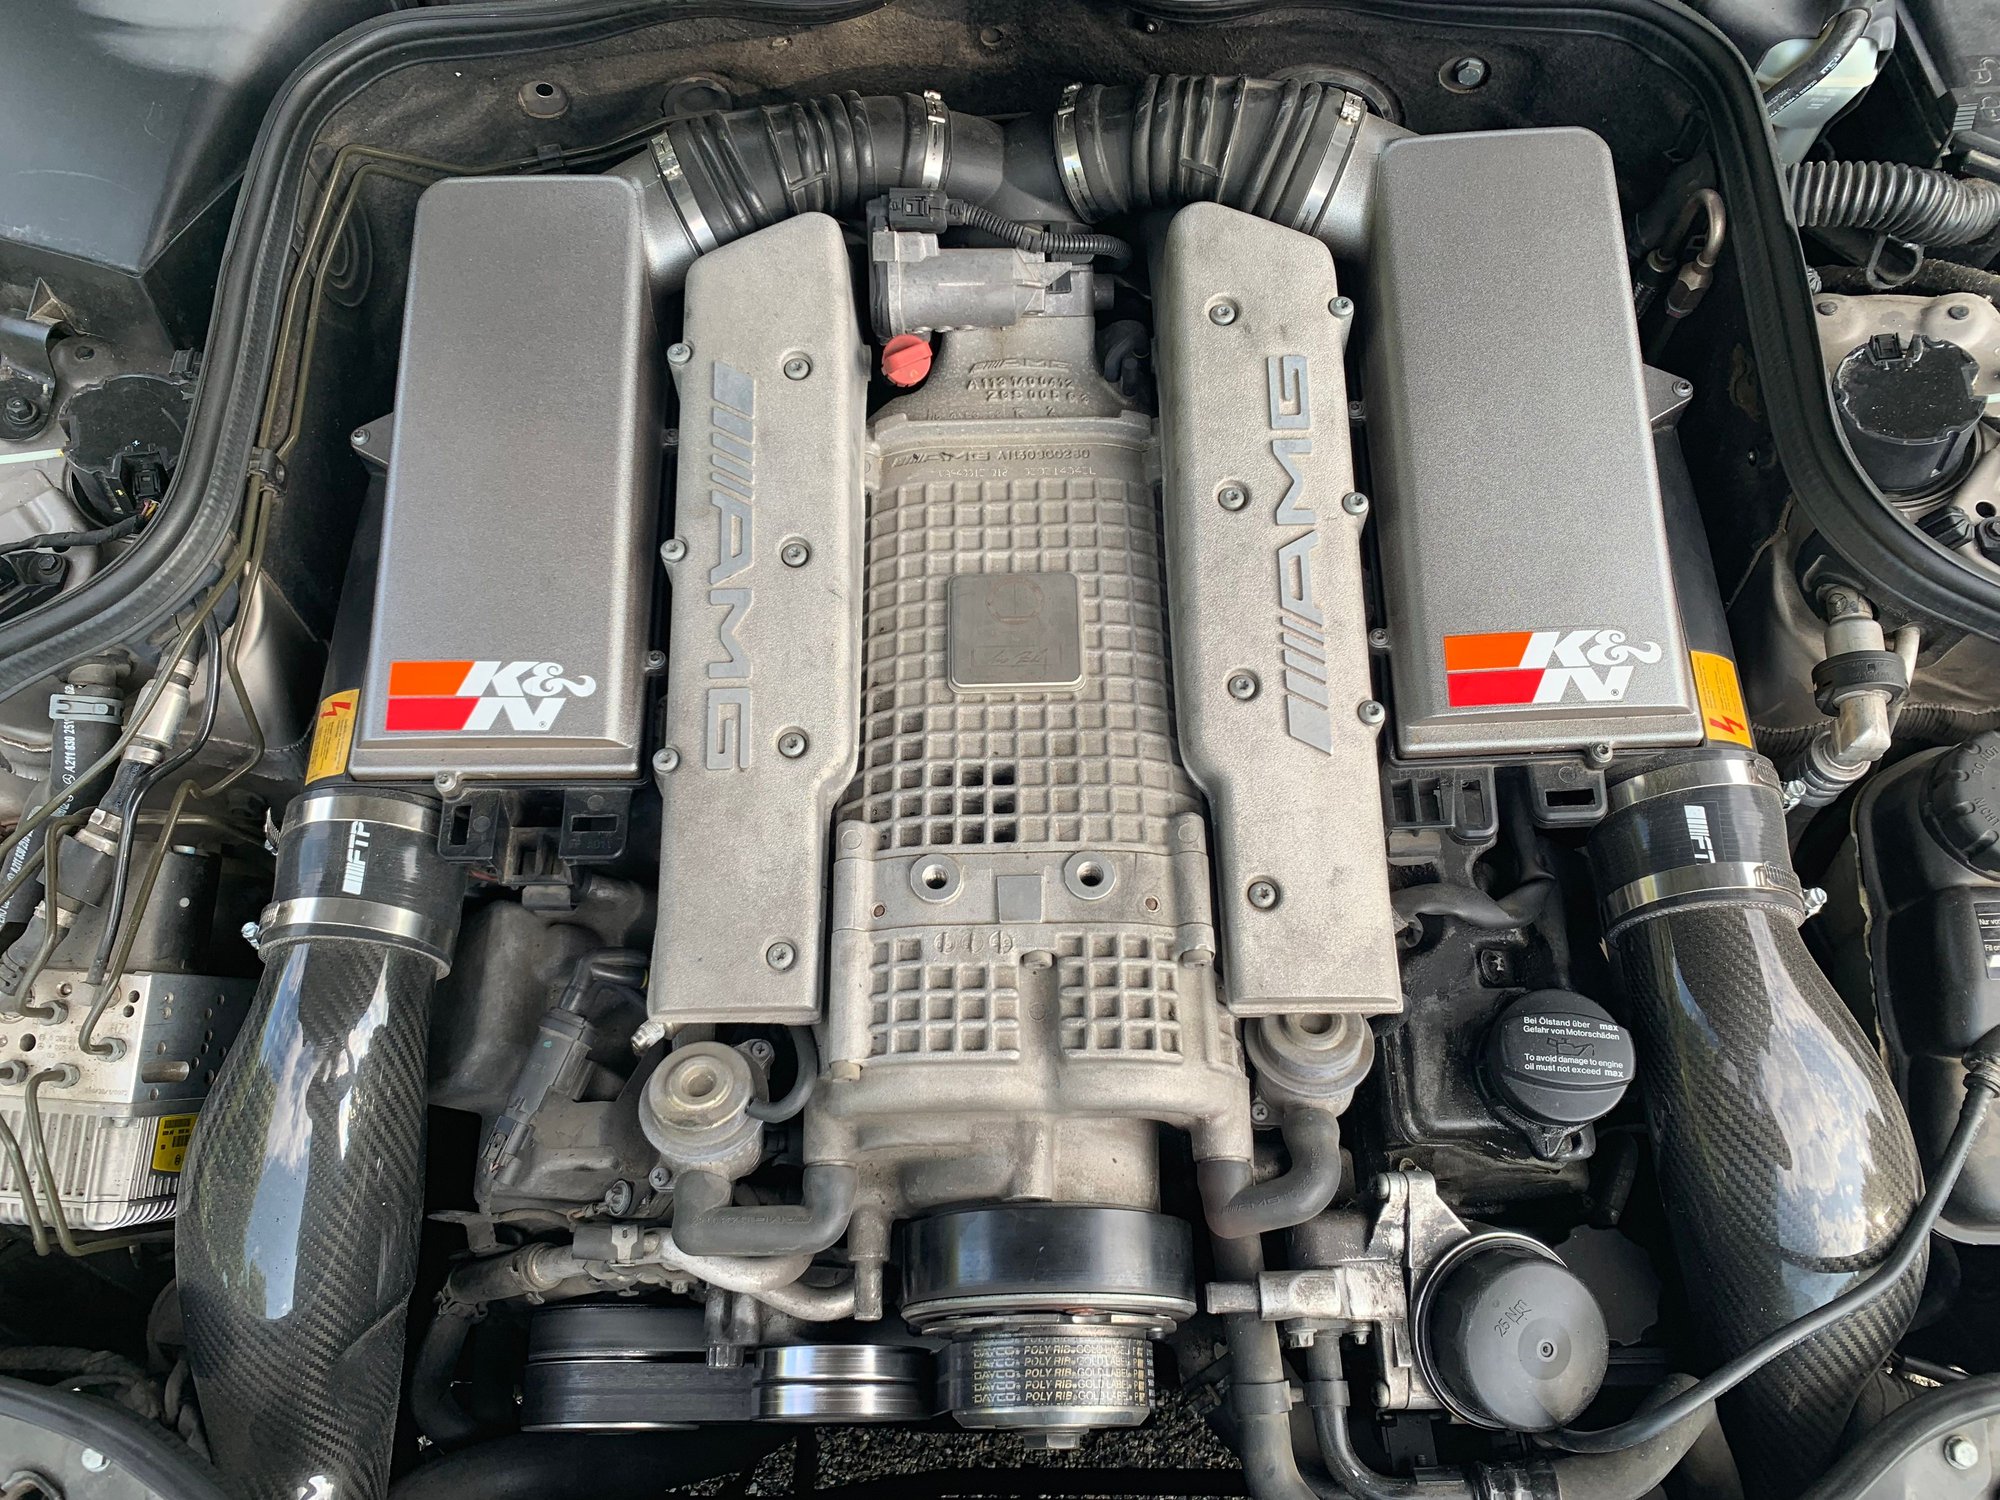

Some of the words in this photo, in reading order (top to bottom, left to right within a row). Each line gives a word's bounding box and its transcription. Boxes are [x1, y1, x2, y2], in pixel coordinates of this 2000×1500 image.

[1268, 355, 1324, 627] AMG
[706, 489, 754, 770] AMG
[1523, 1016, 1537, 1025] Bei
[1539, 1016, 1571, 1027] Ölstand
[1572, 1019, 1591, 1029] über
[1599, 1023, 1619, 1032] max
[1523, 1025, 1550, 1034] Gefahr
[1551, 1027, 1566, 1036] von
[1566, 1028, 1620, 1041] Motorschäden
[1524, 1053, 1535, 1062] To
[1536, 1054, 1557, 1063] avoid
[1558, 1056, 1588, 1066] damage
[1589, 1058, 1597, 1066] to
[1598, 1060, 1624, 1069] engine
[1524, 1062, 1535, 1070] oil
[1536, 1063, 1556, 1072] must
[1557, 1065, 1571, 1073] not
[1571, 1067, 1602, 1076] exceed
[1604, 1069, 1624, 1079] max
[1024, 1345, 1051, 1355] POLY
[1024, 1357, 1052, 1366] POLY
[1025, 1368, 1053, 1378] POLY
[1025, 1380, 1053, 1389] POLY
[1025, 1391, 1053, 1401] POLY
